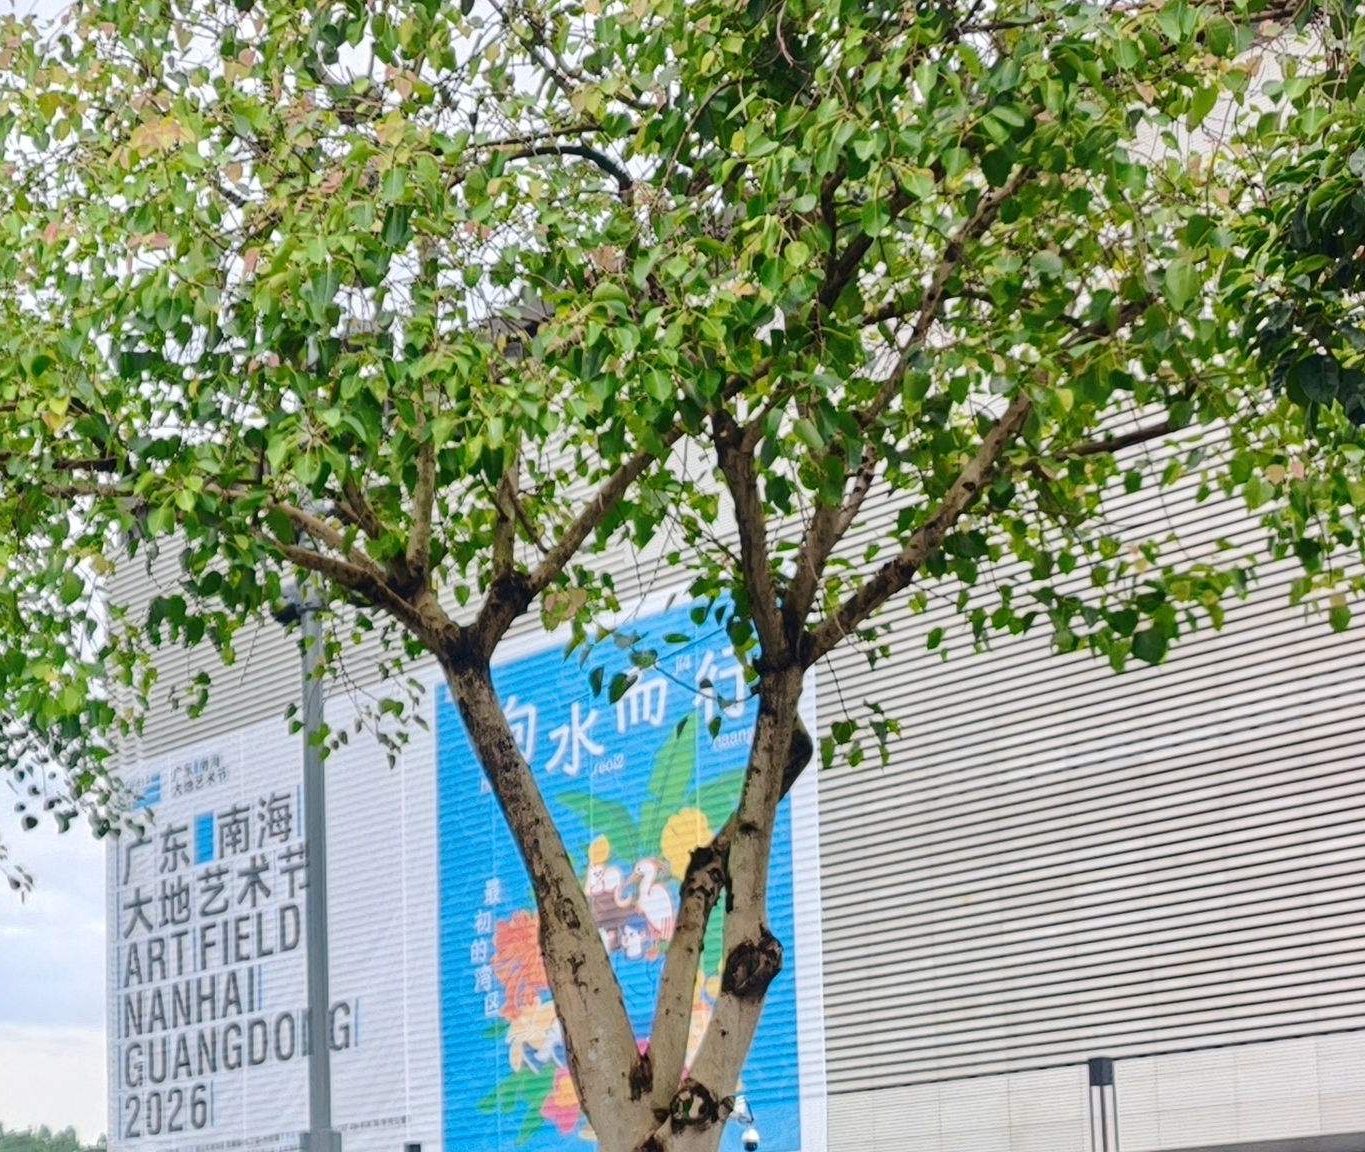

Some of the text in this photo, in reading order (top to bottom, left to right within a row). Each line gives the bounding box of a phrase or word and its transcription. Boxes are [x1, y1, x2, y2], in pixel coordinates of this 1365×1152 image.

[123, 792, 293, 876] 广东 南海
[122, 842, 311, 940] 大地艺术节
[124, 904, 301, 988] ART FIELD
[124, 966, 255, 1039] NANHAI
[125, 1085, 208, 1139] 2026
